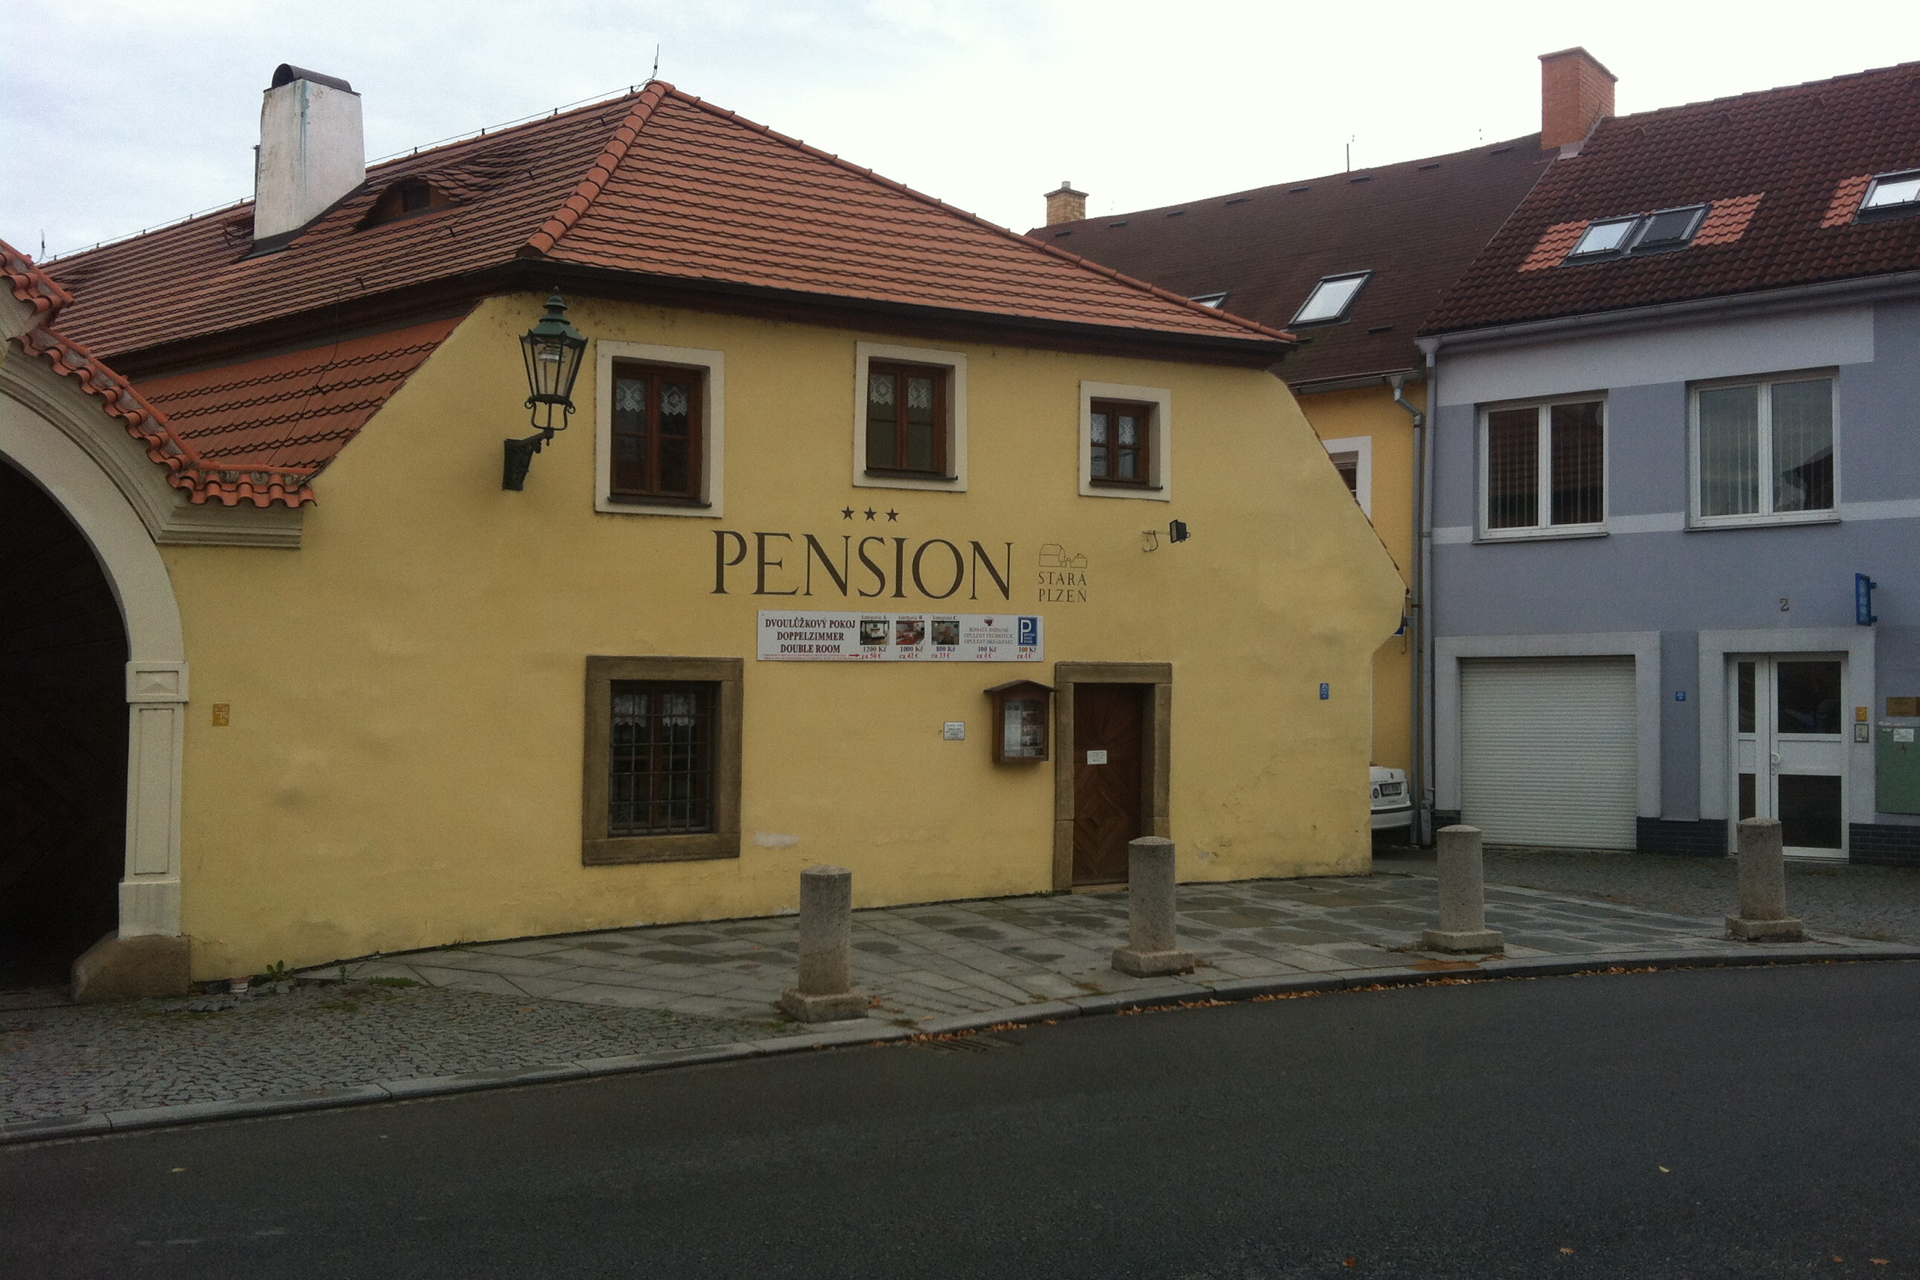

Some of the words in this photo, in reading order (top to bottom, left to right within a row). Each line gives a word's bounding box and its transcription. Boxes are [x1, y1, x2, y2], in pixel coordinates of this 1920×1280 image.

[709, 529, 1013, 601] PENSION
[1038, 570, 1087, 586] STARÁ
[1038, 587, 1087, 602] PLZEŇ
[1779, 598, 1790, 612] 2
[765, 617, 827, 629] DVOULŮŽKOVÝ
[829, 620, 856, 629] POKOJ
[776, 631, 845, 641] DOPPELZIMMER
[1020, 619, 1032, 644] P
[780, 644, 814, 653] DOUBLE
[815, 644, 841, 653] ROOM
